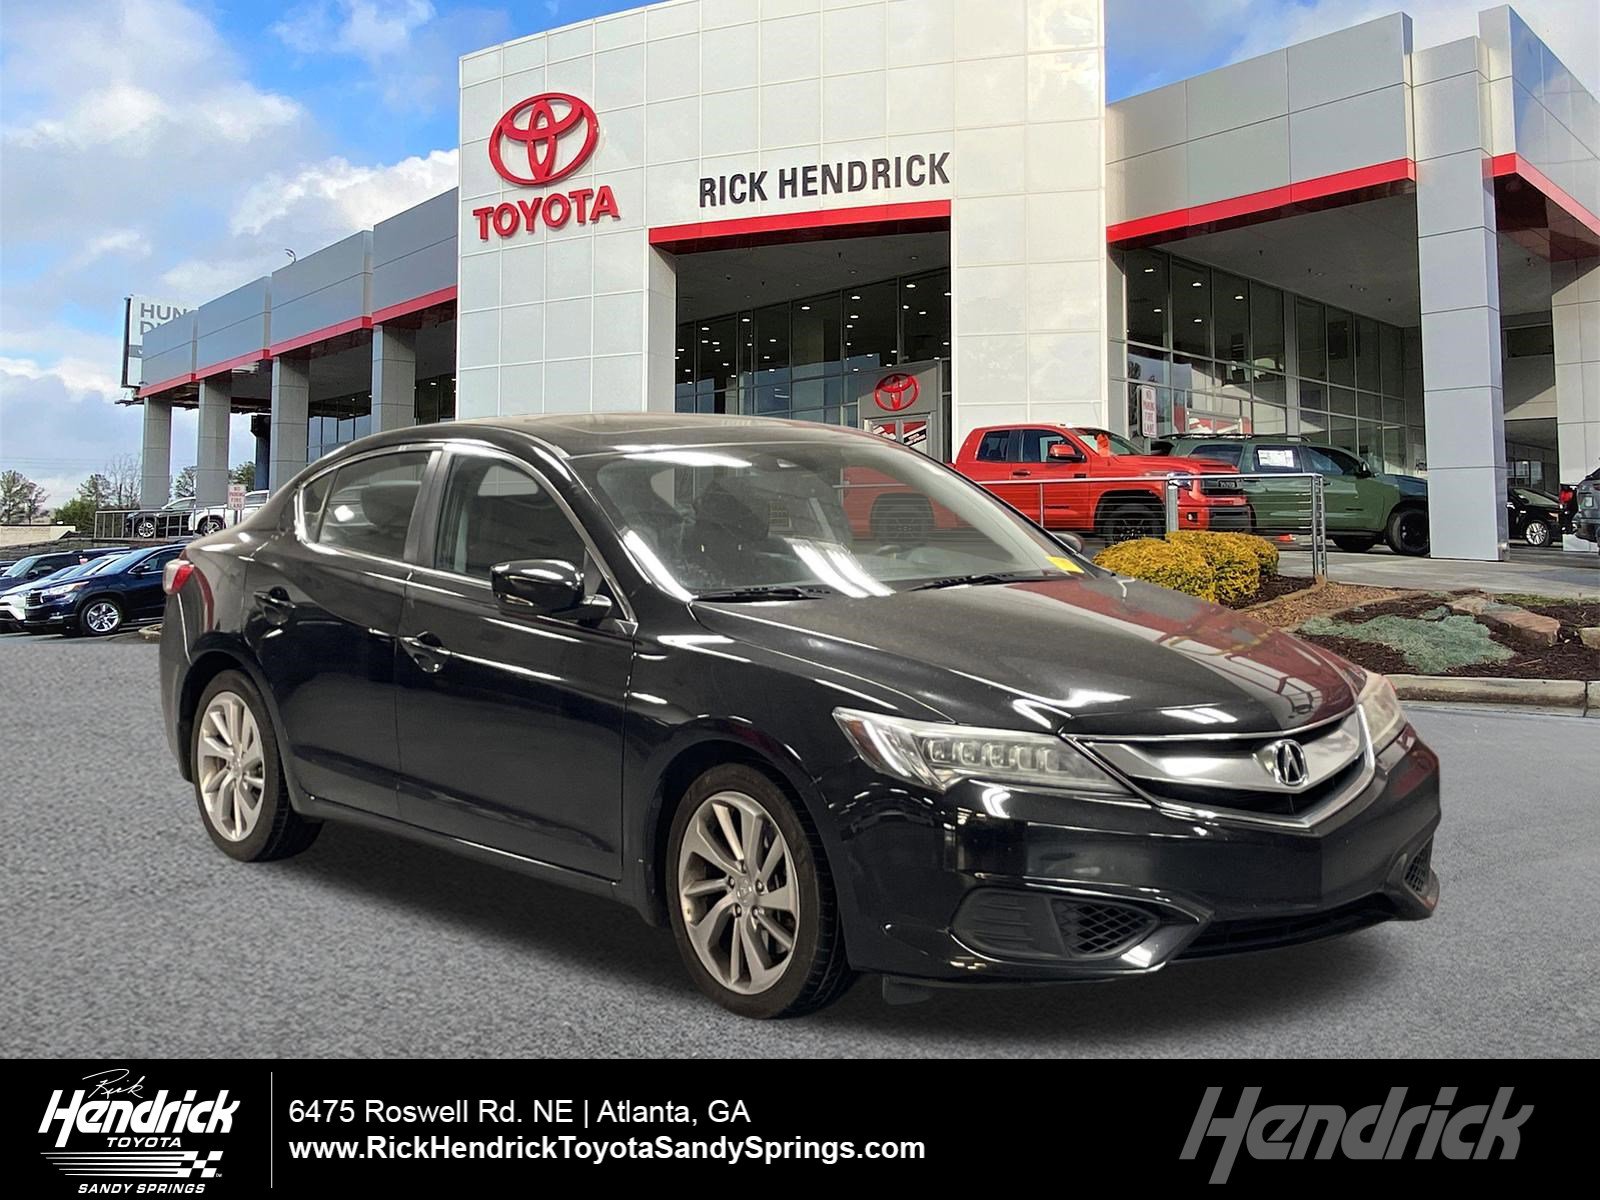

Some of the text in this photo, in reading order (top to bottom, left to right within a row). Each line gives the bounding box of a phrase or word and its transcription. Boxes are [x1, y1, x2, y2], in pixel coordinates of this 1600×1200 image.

[699, 151, 951, 208] RICK HENDRICK
[472, 185, 621, 241] TOYOTA
